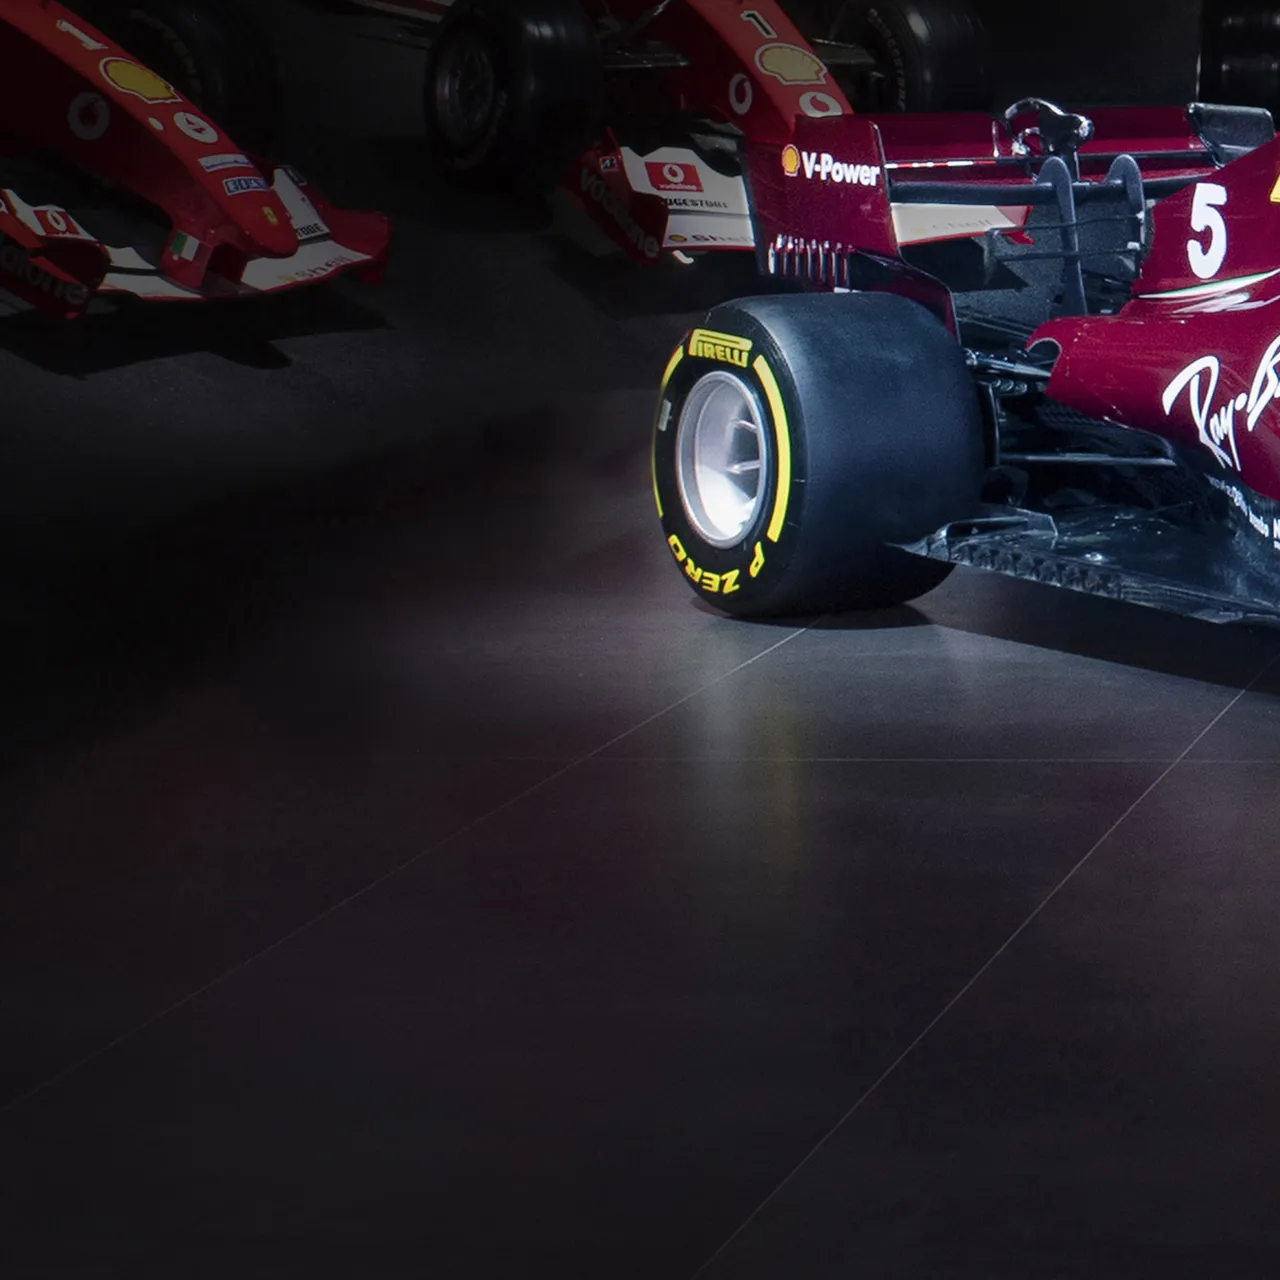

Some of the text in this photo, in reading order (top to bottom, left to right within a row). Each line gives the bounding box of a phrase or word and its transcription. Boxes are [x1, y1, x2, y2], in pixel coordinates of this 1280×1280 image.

[741, 10, 767, 38] 1
[801, 150, 881, 187] V-Power
[1187, 183, 1227, 278] 5
[689, 328, 753, 368] PIRELLI
[667, 533, 740, 594] ZERO
